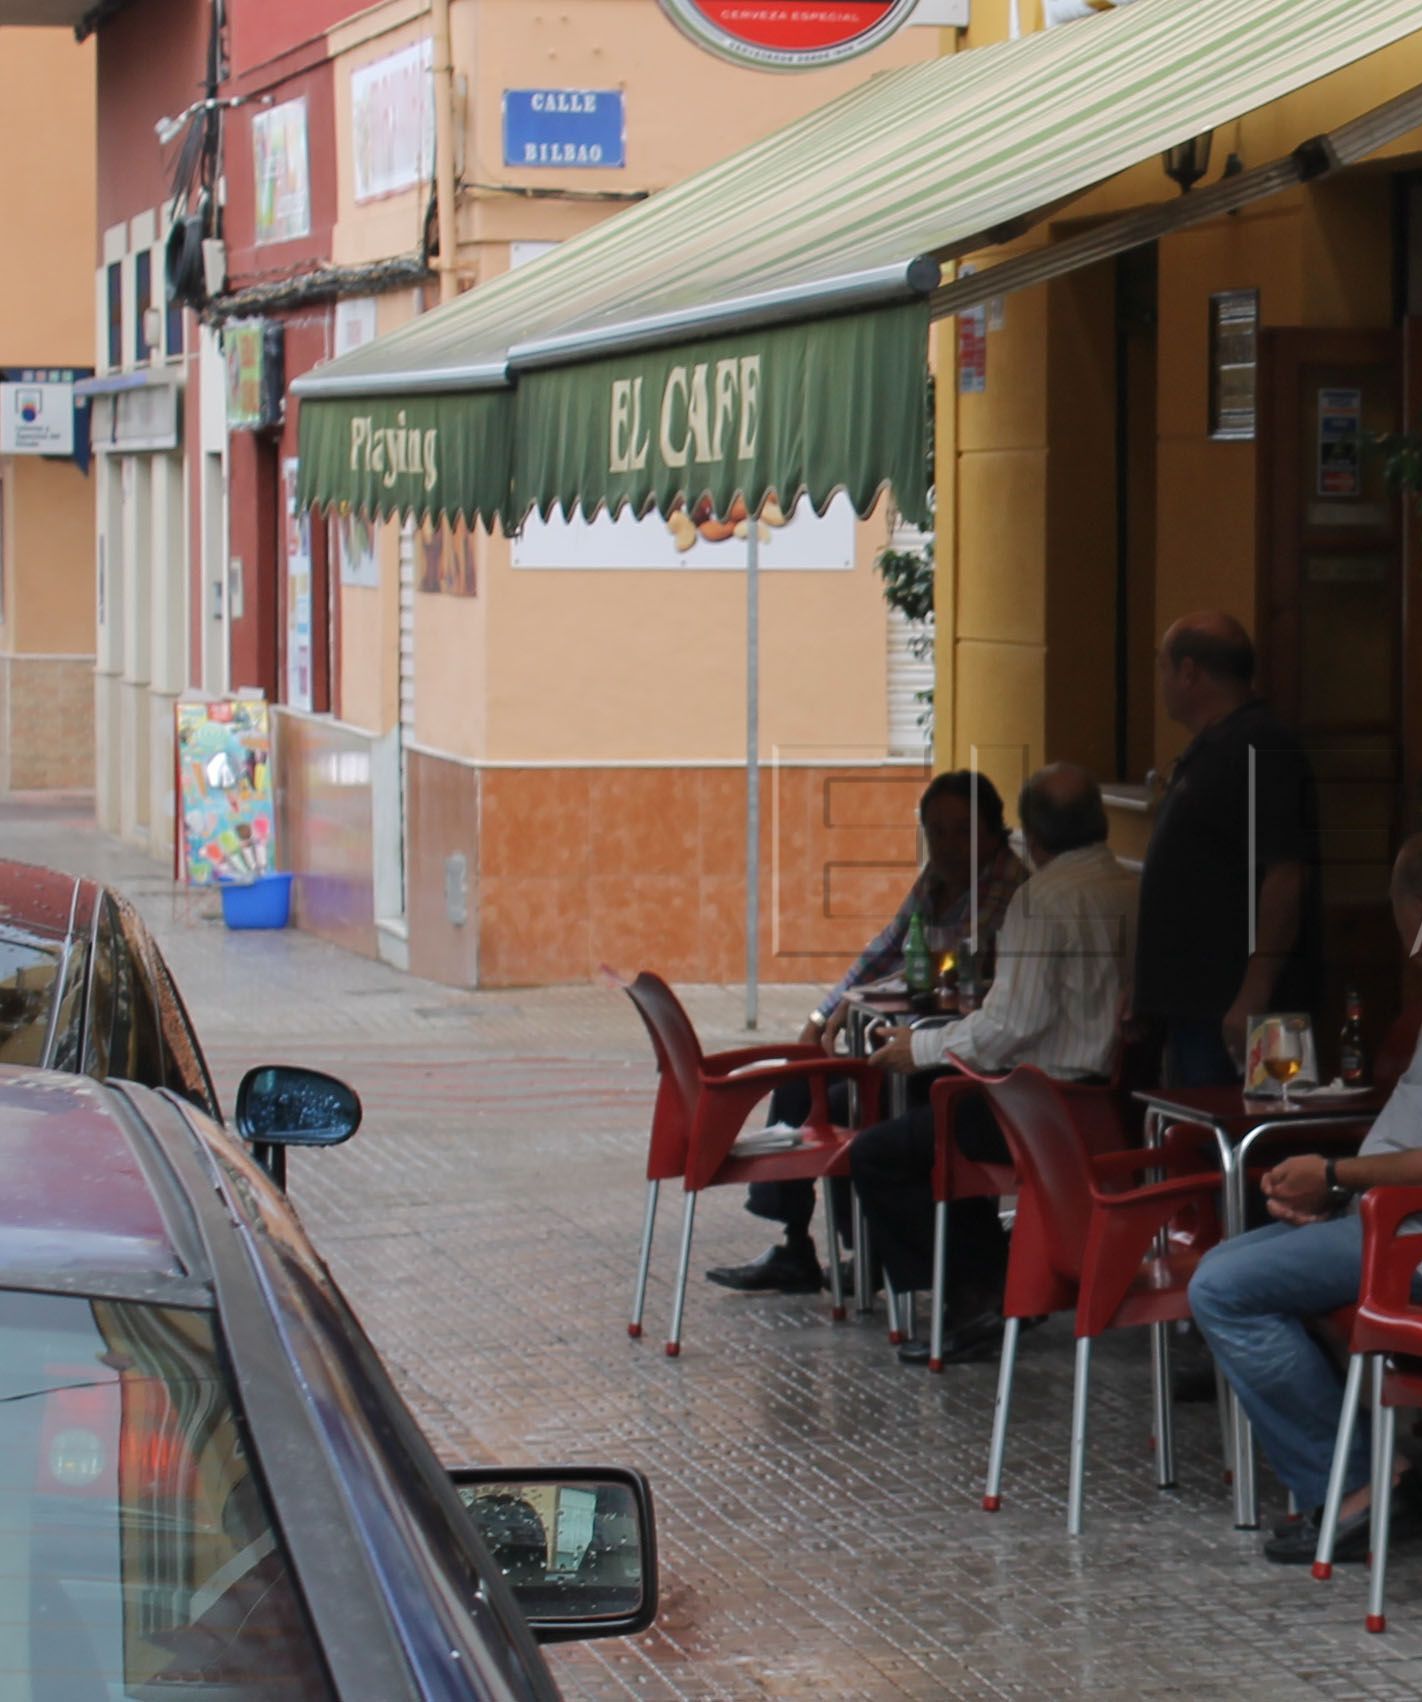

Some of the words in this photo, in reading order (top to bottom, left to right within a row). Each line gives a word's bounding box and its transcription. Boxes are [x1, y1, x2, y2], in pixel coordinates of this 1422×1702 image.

[720, 9, 787, 21] CERVEZA
[791, 11, 860, 23] ESPECIAL
[530, 92, 597, 113] CALLE
[524, 142, 603, 163] BILBAO
[609, 376, 650, 473] EL
[658, 354, 761, 468] CAFE
[350, 410, 438, 492] Playing
